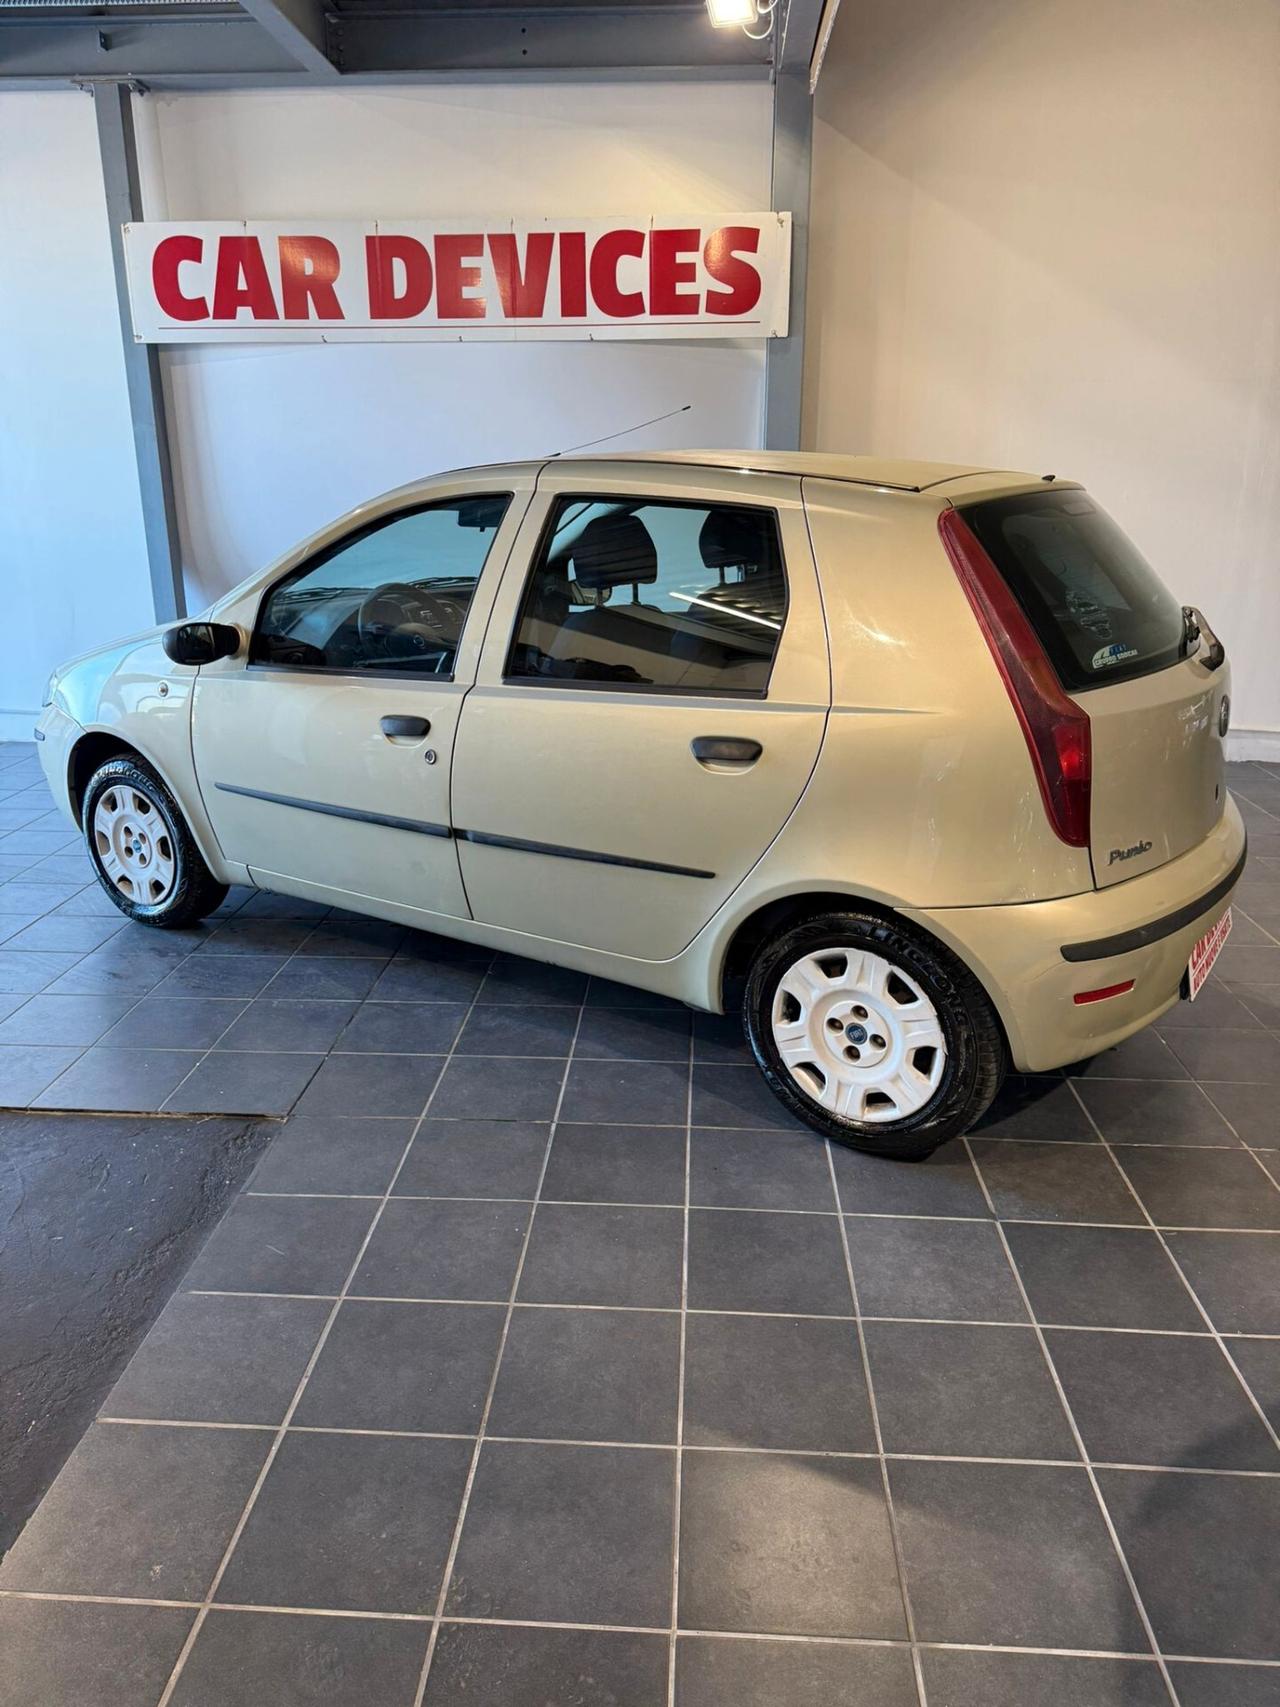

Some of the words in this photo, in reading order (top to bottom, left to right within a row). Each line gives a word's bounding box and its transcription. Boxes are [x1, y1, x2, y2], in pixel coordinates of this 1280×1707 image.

[152, 235, 345, 321] CAR
[366, 227, 761, 319] DEVICES
[1109, 840, 1152, 866] Punto
